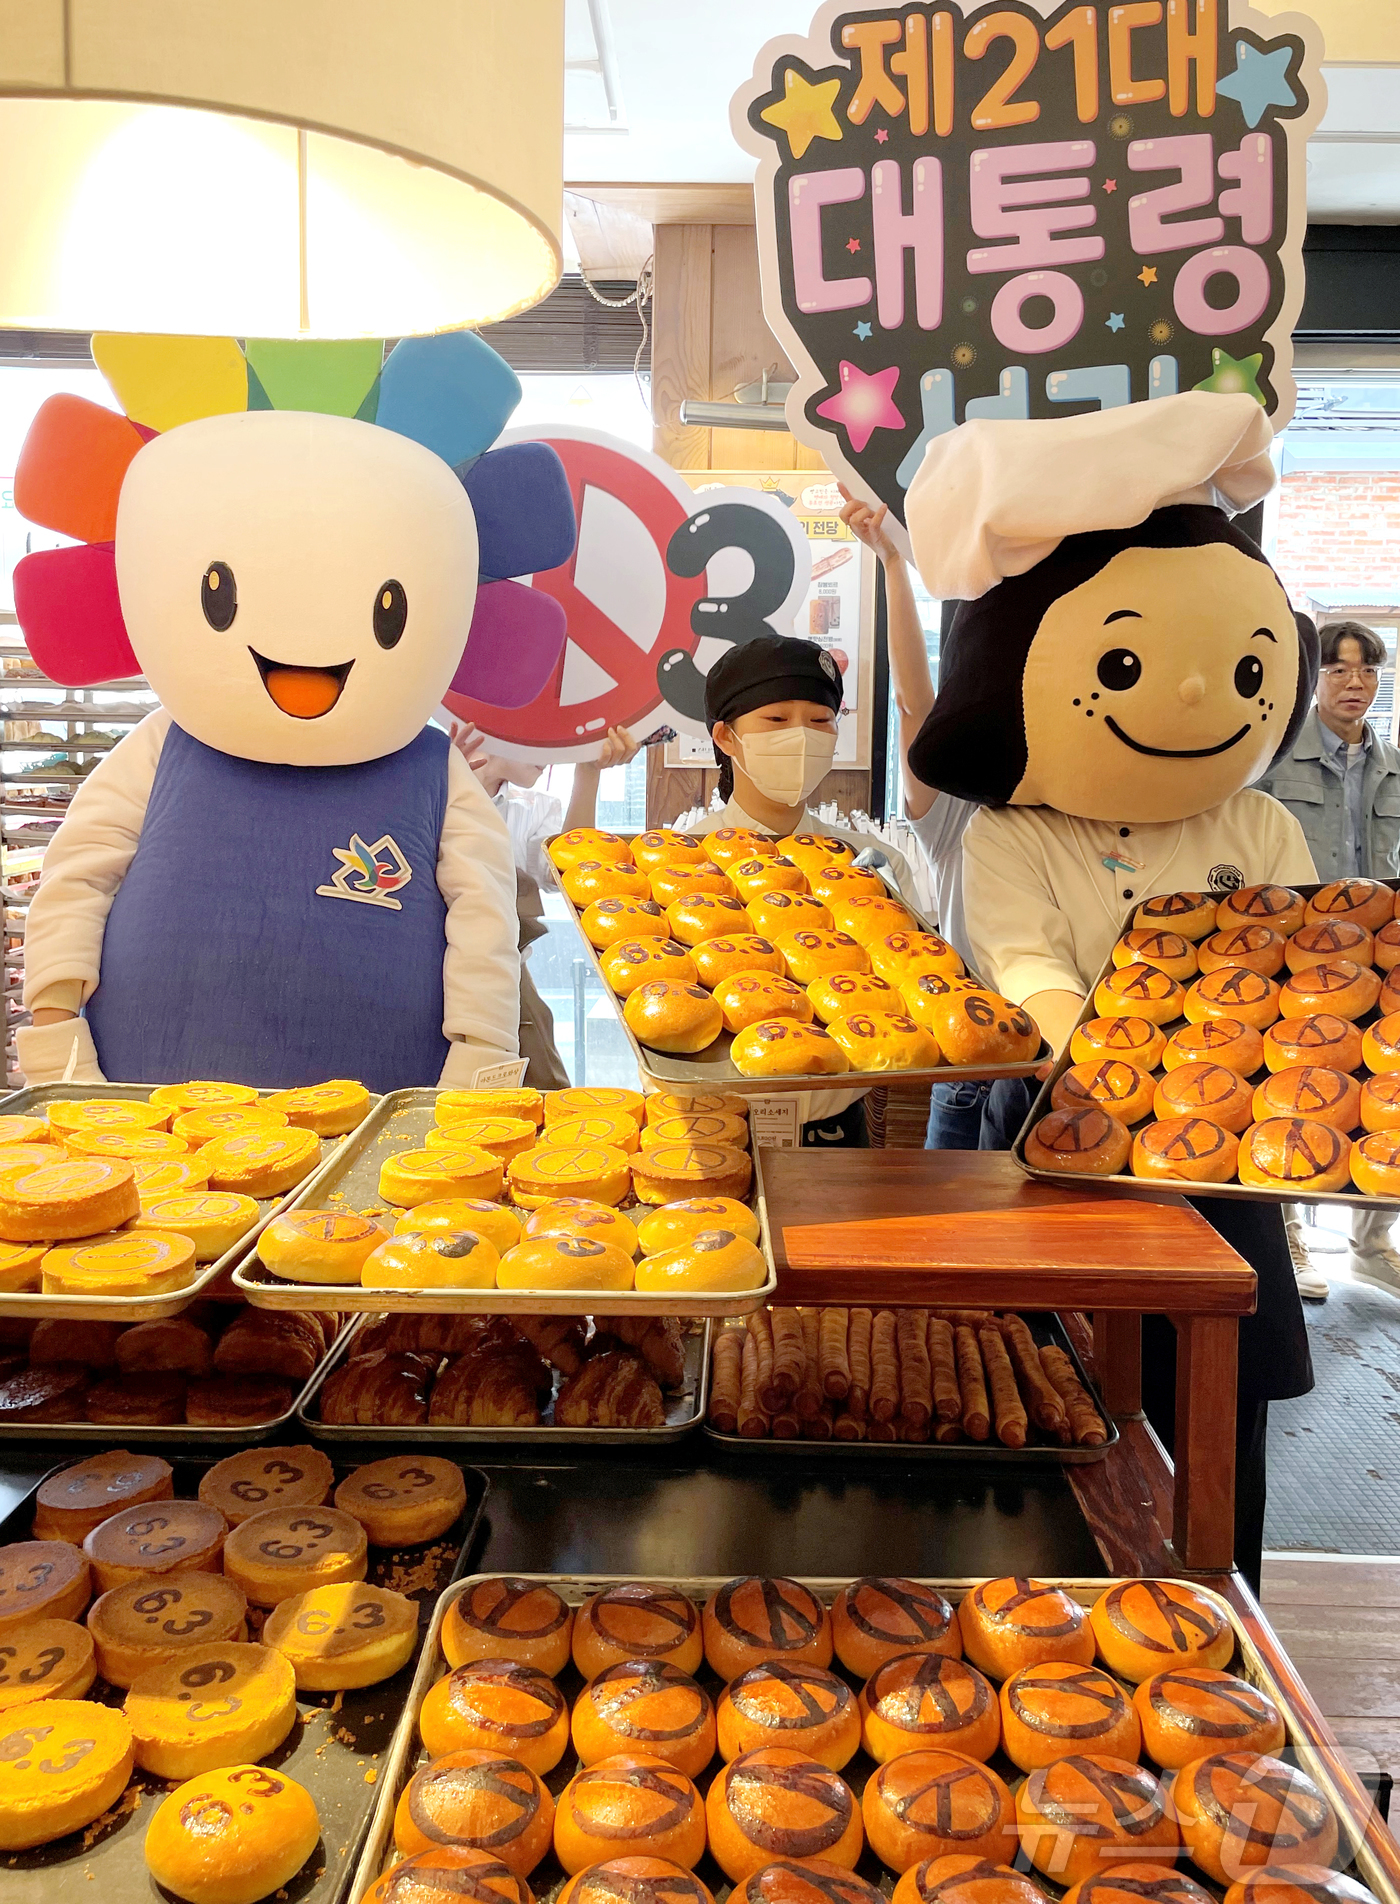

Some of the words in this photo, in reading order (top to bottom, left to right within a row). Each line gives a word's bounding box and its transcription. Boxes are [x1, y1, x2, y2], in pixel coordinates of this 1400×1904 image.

[841, 0, 1218, 136] 제21대
[788, 132, 1274, 354] 대통령
[813, 521, 839, 535] 전당
[657, 503, 796, 722] 3
[640, 832, 699, 848] 6.3
[794, 834, 846, 854] 6.3
[707, 935, 775, 955] 6.3
[794, 929, 858, 950] 6.3
[883, 931, 947, 957] 6.3
[733, 976, 801, 995] 6.3
[846, 1013, 918, 1038] 6.3
[964, 996, 1034, 1037] 6.3
[230, 1461, 305, 1503] 6.3
[361, 1467, 436, 1500] 6.3
[258, 1519, 333, 1560] 6.3
[133, 1588, 213, 1636] 6.3
[297, 1602, 386, 1636] 6.3
[178, 1660, 243, 1722] 6.3
[0, 1725, 97, 1774] 6.3
[178, 1767, 285, 1838] 6.3
